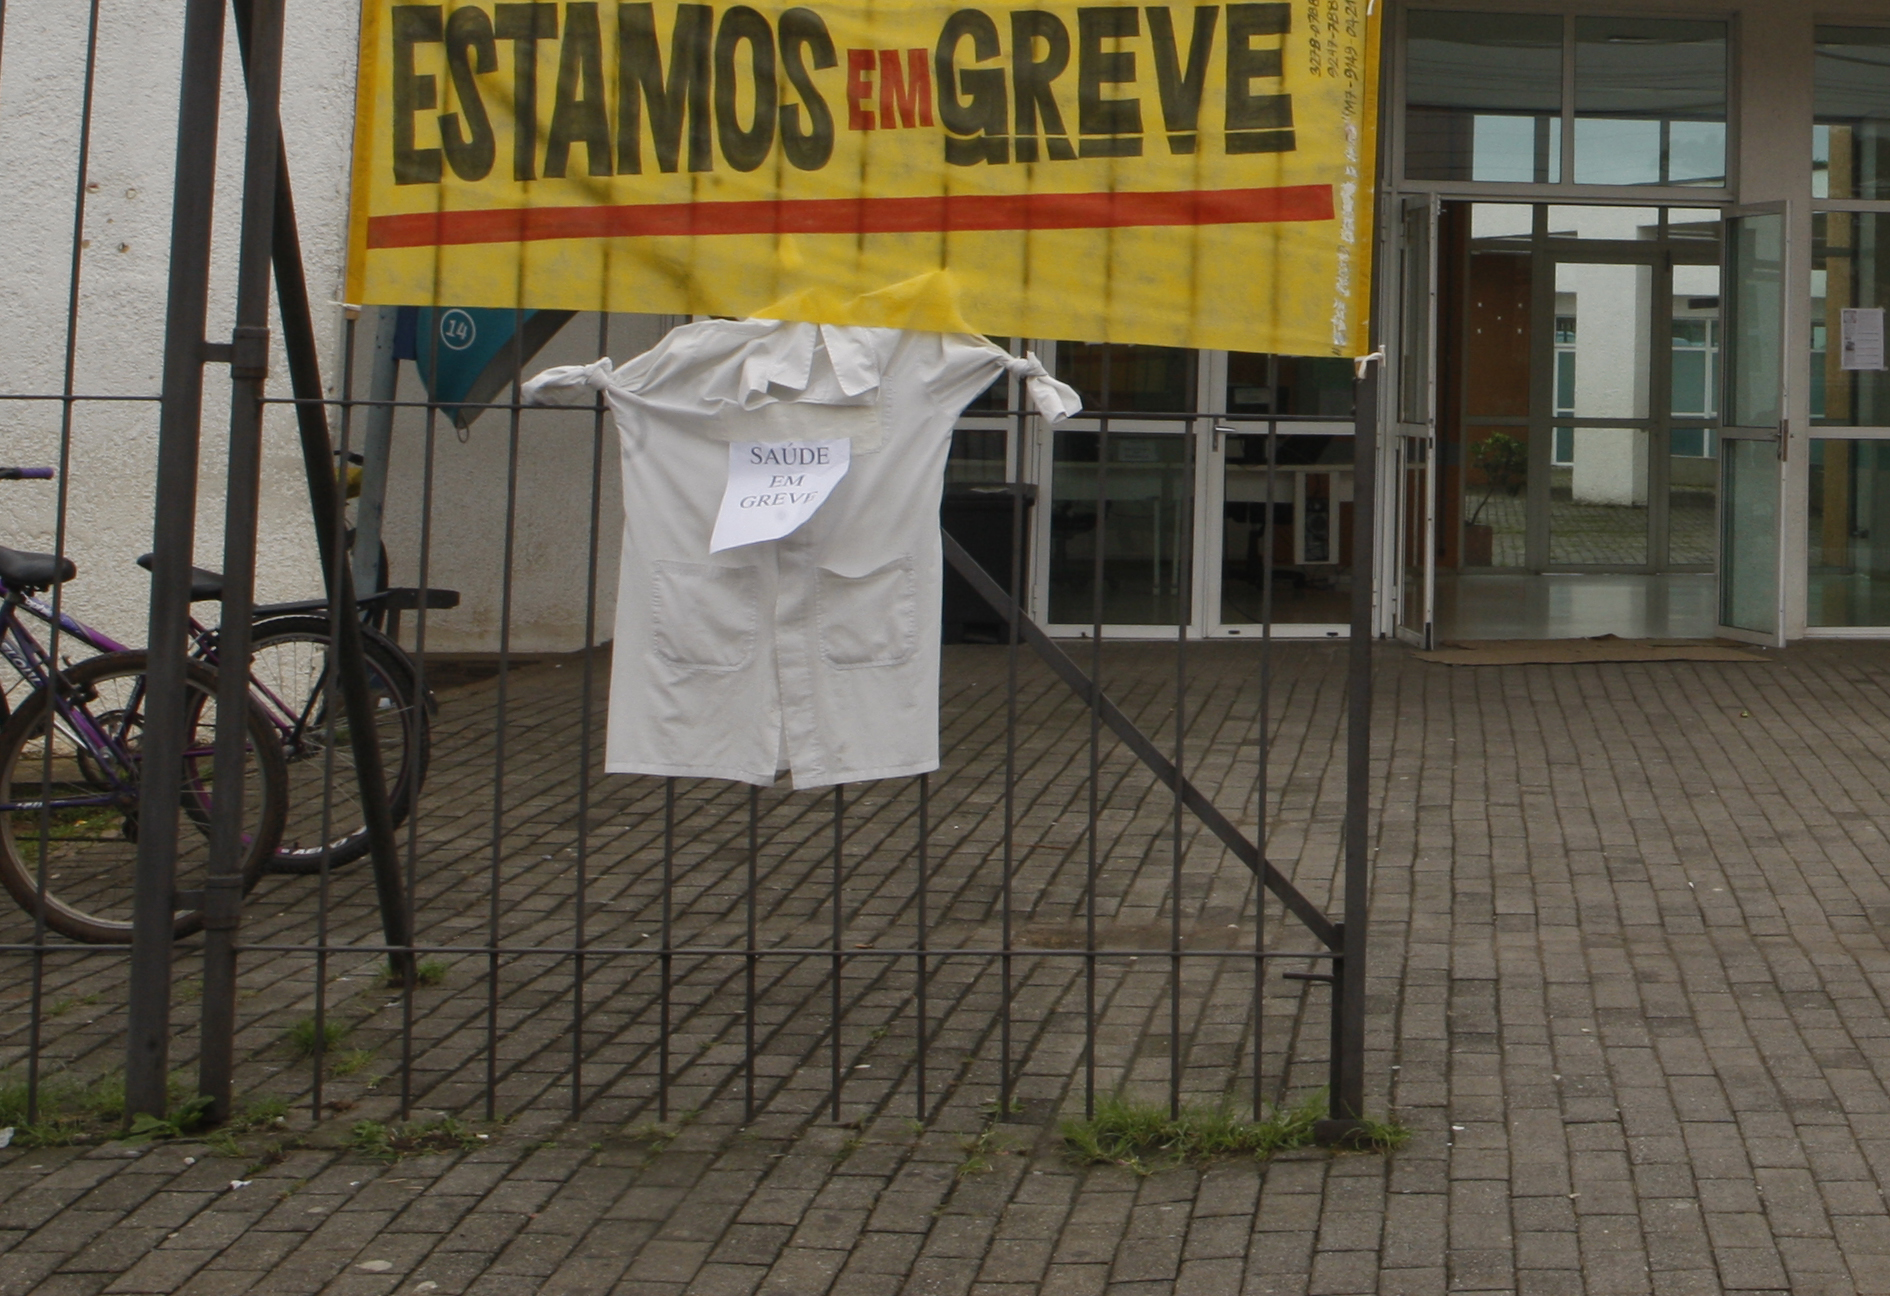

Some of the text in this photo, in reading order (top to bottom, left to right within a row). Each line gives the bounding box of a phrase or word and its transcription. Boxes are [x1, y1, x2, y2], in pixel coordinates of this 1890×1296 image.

[391, 0, 1297, 186] ESTAMOS EM GREVE
[445, 319, 468, 340] 14
[750, 442, 830, 466] SAÚDE
[768, 474, 806, 489] EM
[739, 490, 819, 509] GREVE
